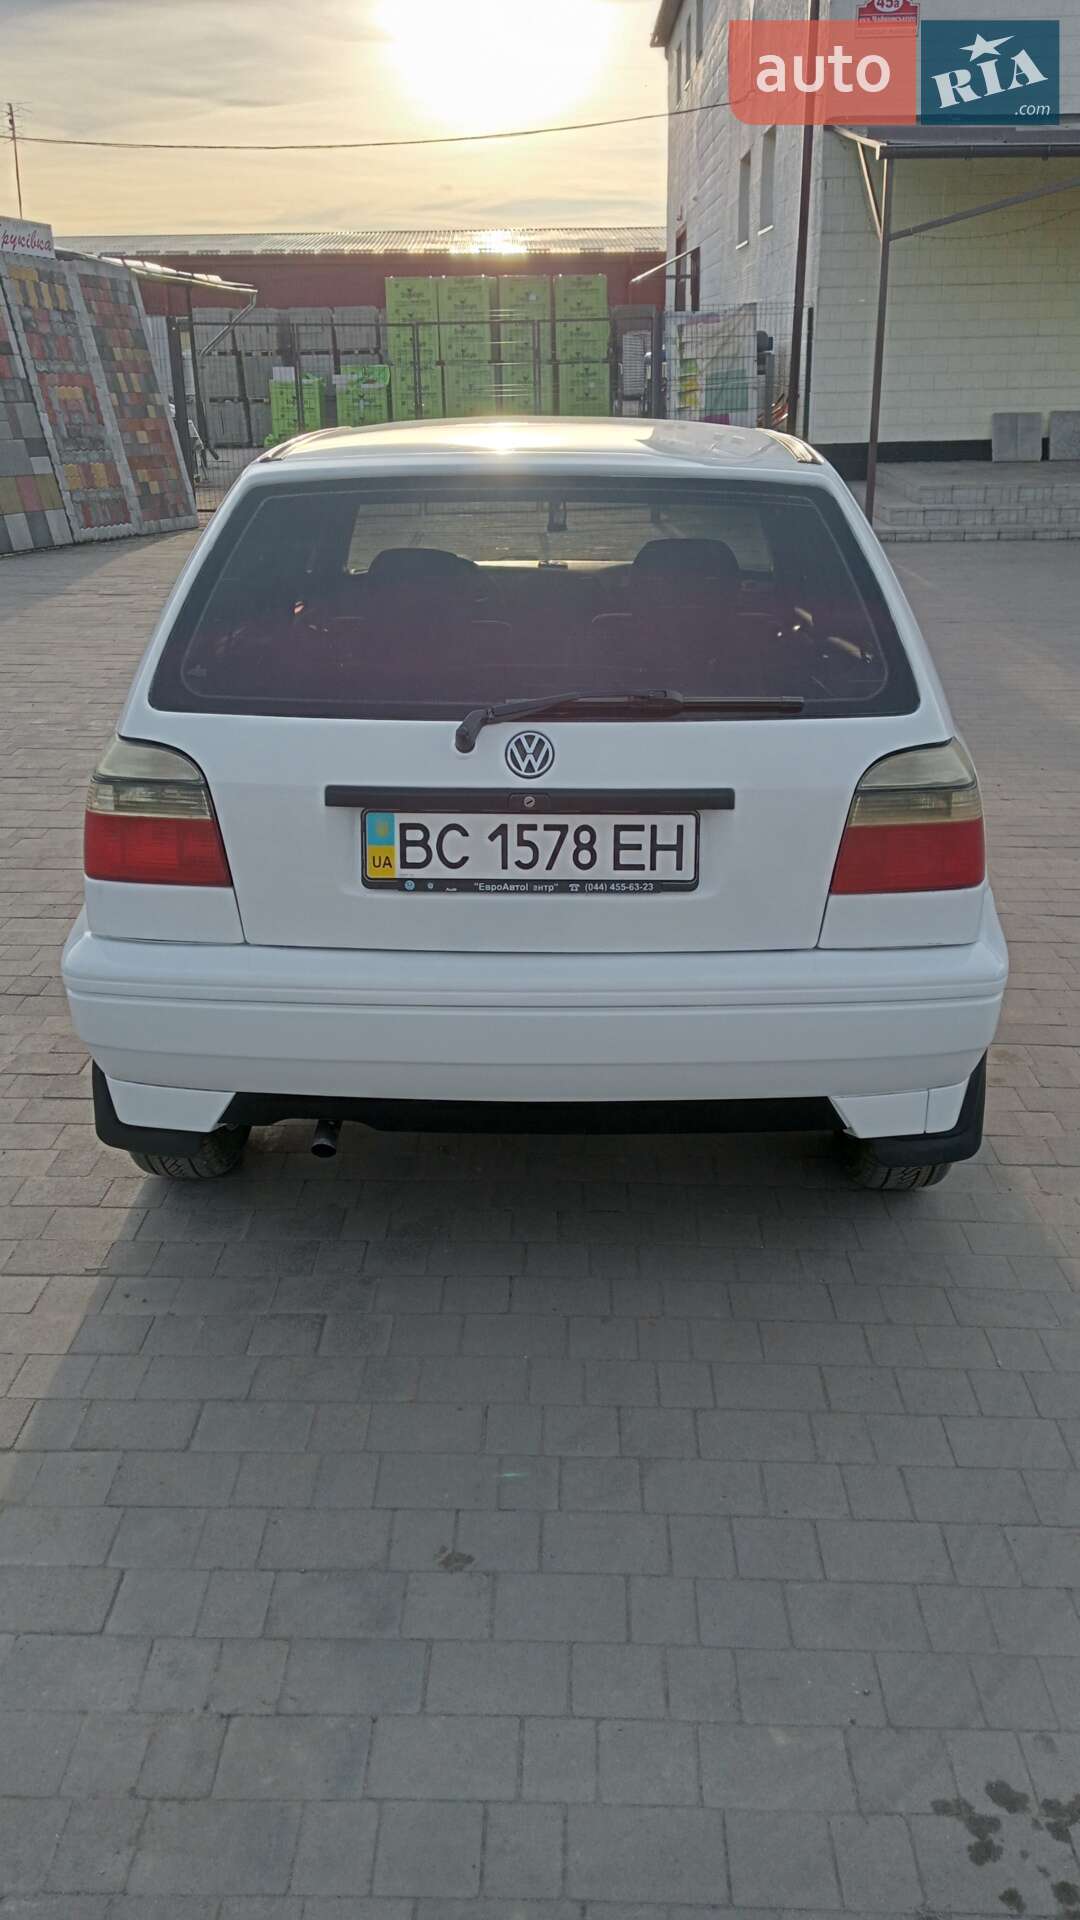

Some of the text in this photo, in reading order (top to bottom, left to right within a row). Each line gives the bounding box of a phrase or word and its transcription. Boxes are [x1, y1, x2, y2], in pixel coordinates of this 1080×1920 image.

[0, 229, 51, 251] руківка
[399, 822, 684, 871] BC 1578 EH
[372, 856, 393, 869] UA
[584, 883, 608, 893] (044)
[609, 883, 654, 893] 455-63-23
